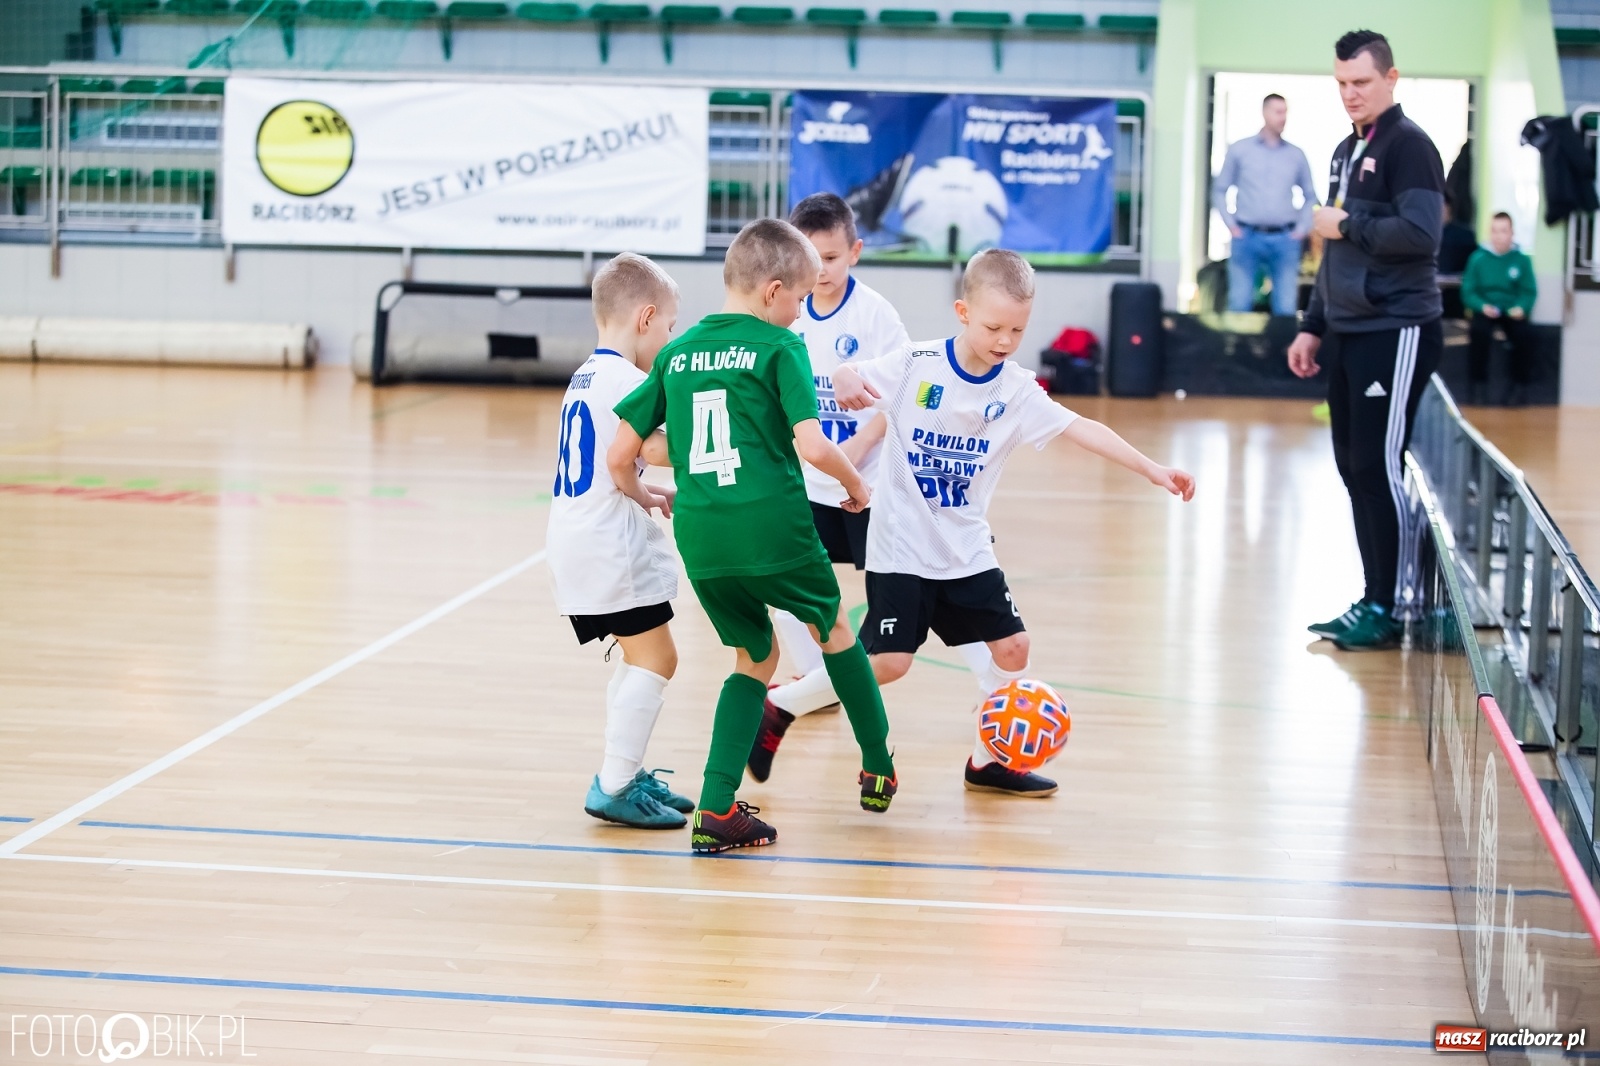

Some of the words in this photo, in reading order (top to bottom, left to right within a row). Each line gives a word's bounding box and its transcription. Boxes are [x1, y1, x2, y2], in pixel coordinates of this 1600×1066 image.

[1006, 122, 1085, 145] SPORT
[377, 176, 447, 217] JEST
[458, 165, 488, 193] W
[494, 113, 679, 182] PORZĄDKU!
[252, 203, 356, 222] RACIBÓRZ
[668, 353, 687, 375] FC
[690, 346, 758, 372] HLUČÍN
[553, 399, 596, 498] 10
[689, 388, 742, 487] 4
[912, 428, 990, 454] PAWILON
